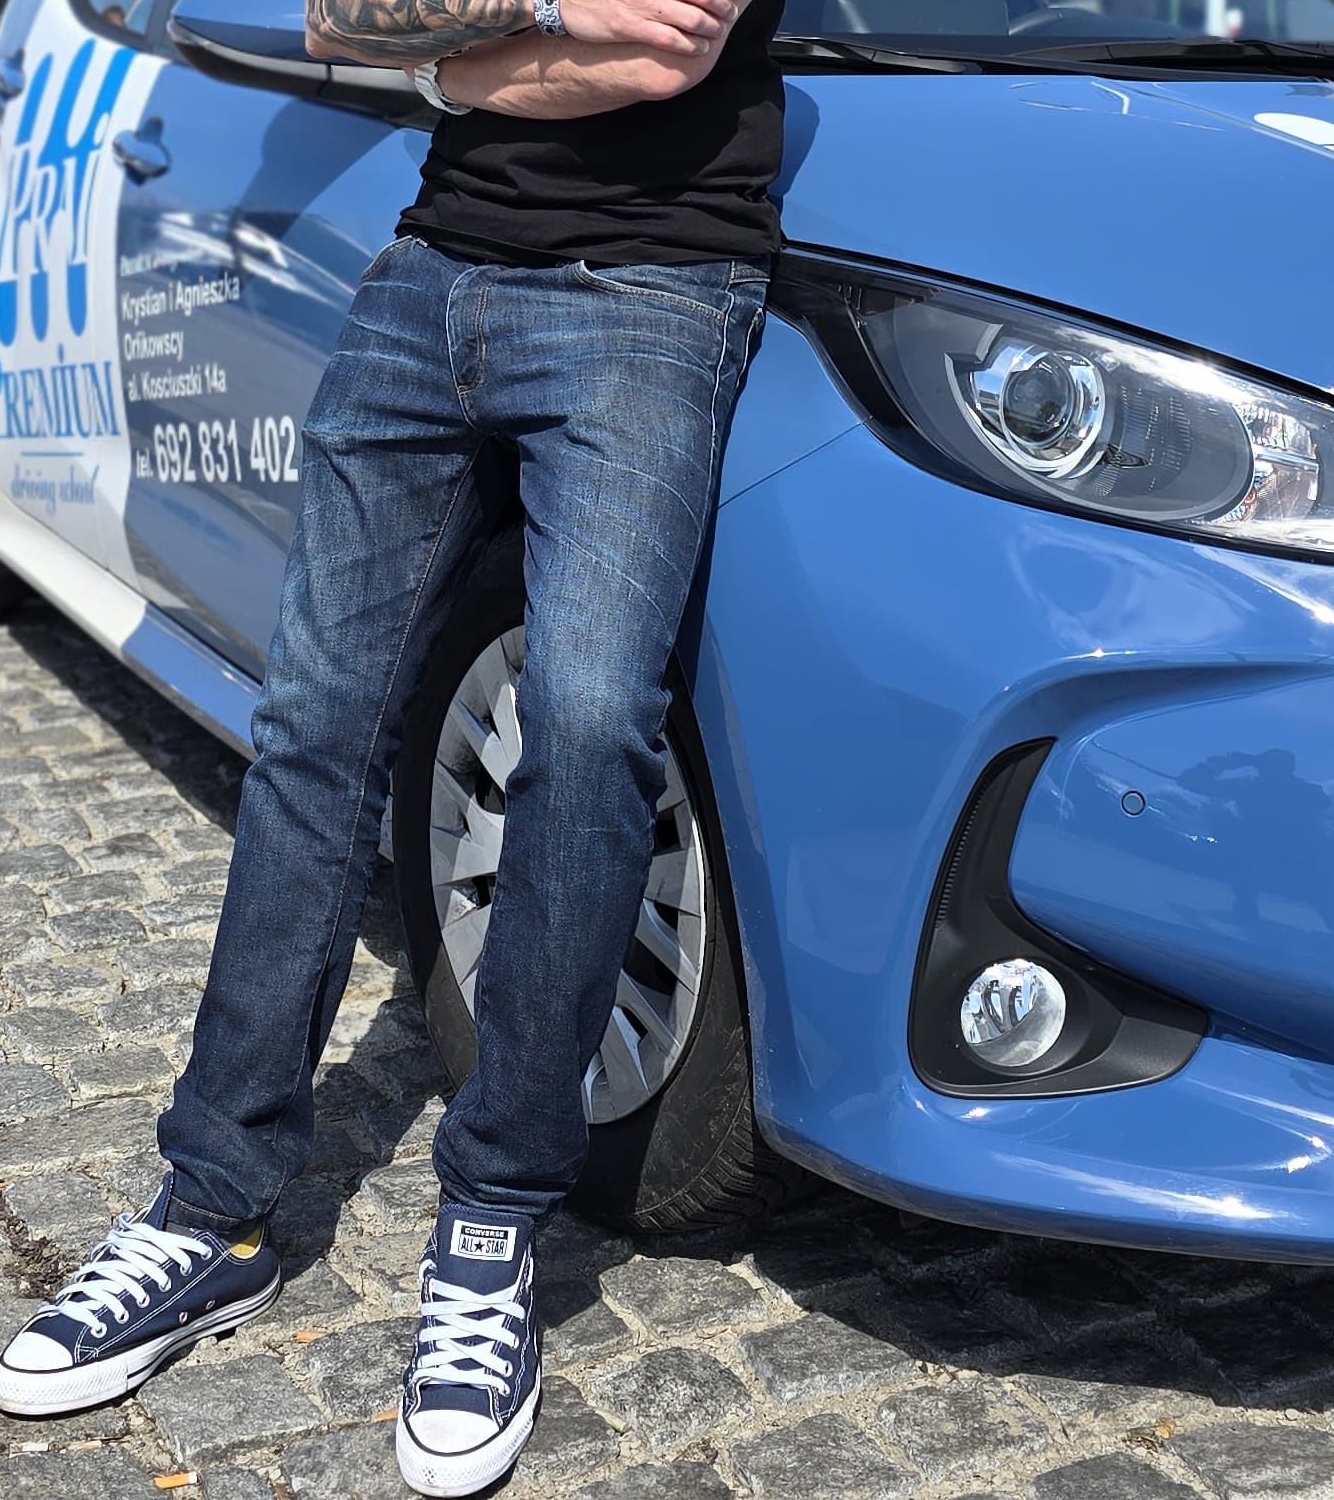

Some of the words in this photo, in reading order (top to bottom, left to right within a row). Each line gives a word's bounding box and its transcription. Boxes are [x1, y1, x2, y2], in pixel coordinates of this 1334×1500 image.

[175, 270, 241, 316] Agnieszka
[204, 362, 228, 395] 14a
[136, 447, 154, 479] tel.
[153, 421, 197, 484] 692
[198, 417, 242, 484] 831
[250, 414, 300, 483] 402
[460, 1236, 474, 1253] ALL
[485, 1239, 505, 1255] STAR
[464, 1227, 505, 1238] CONVERSE
